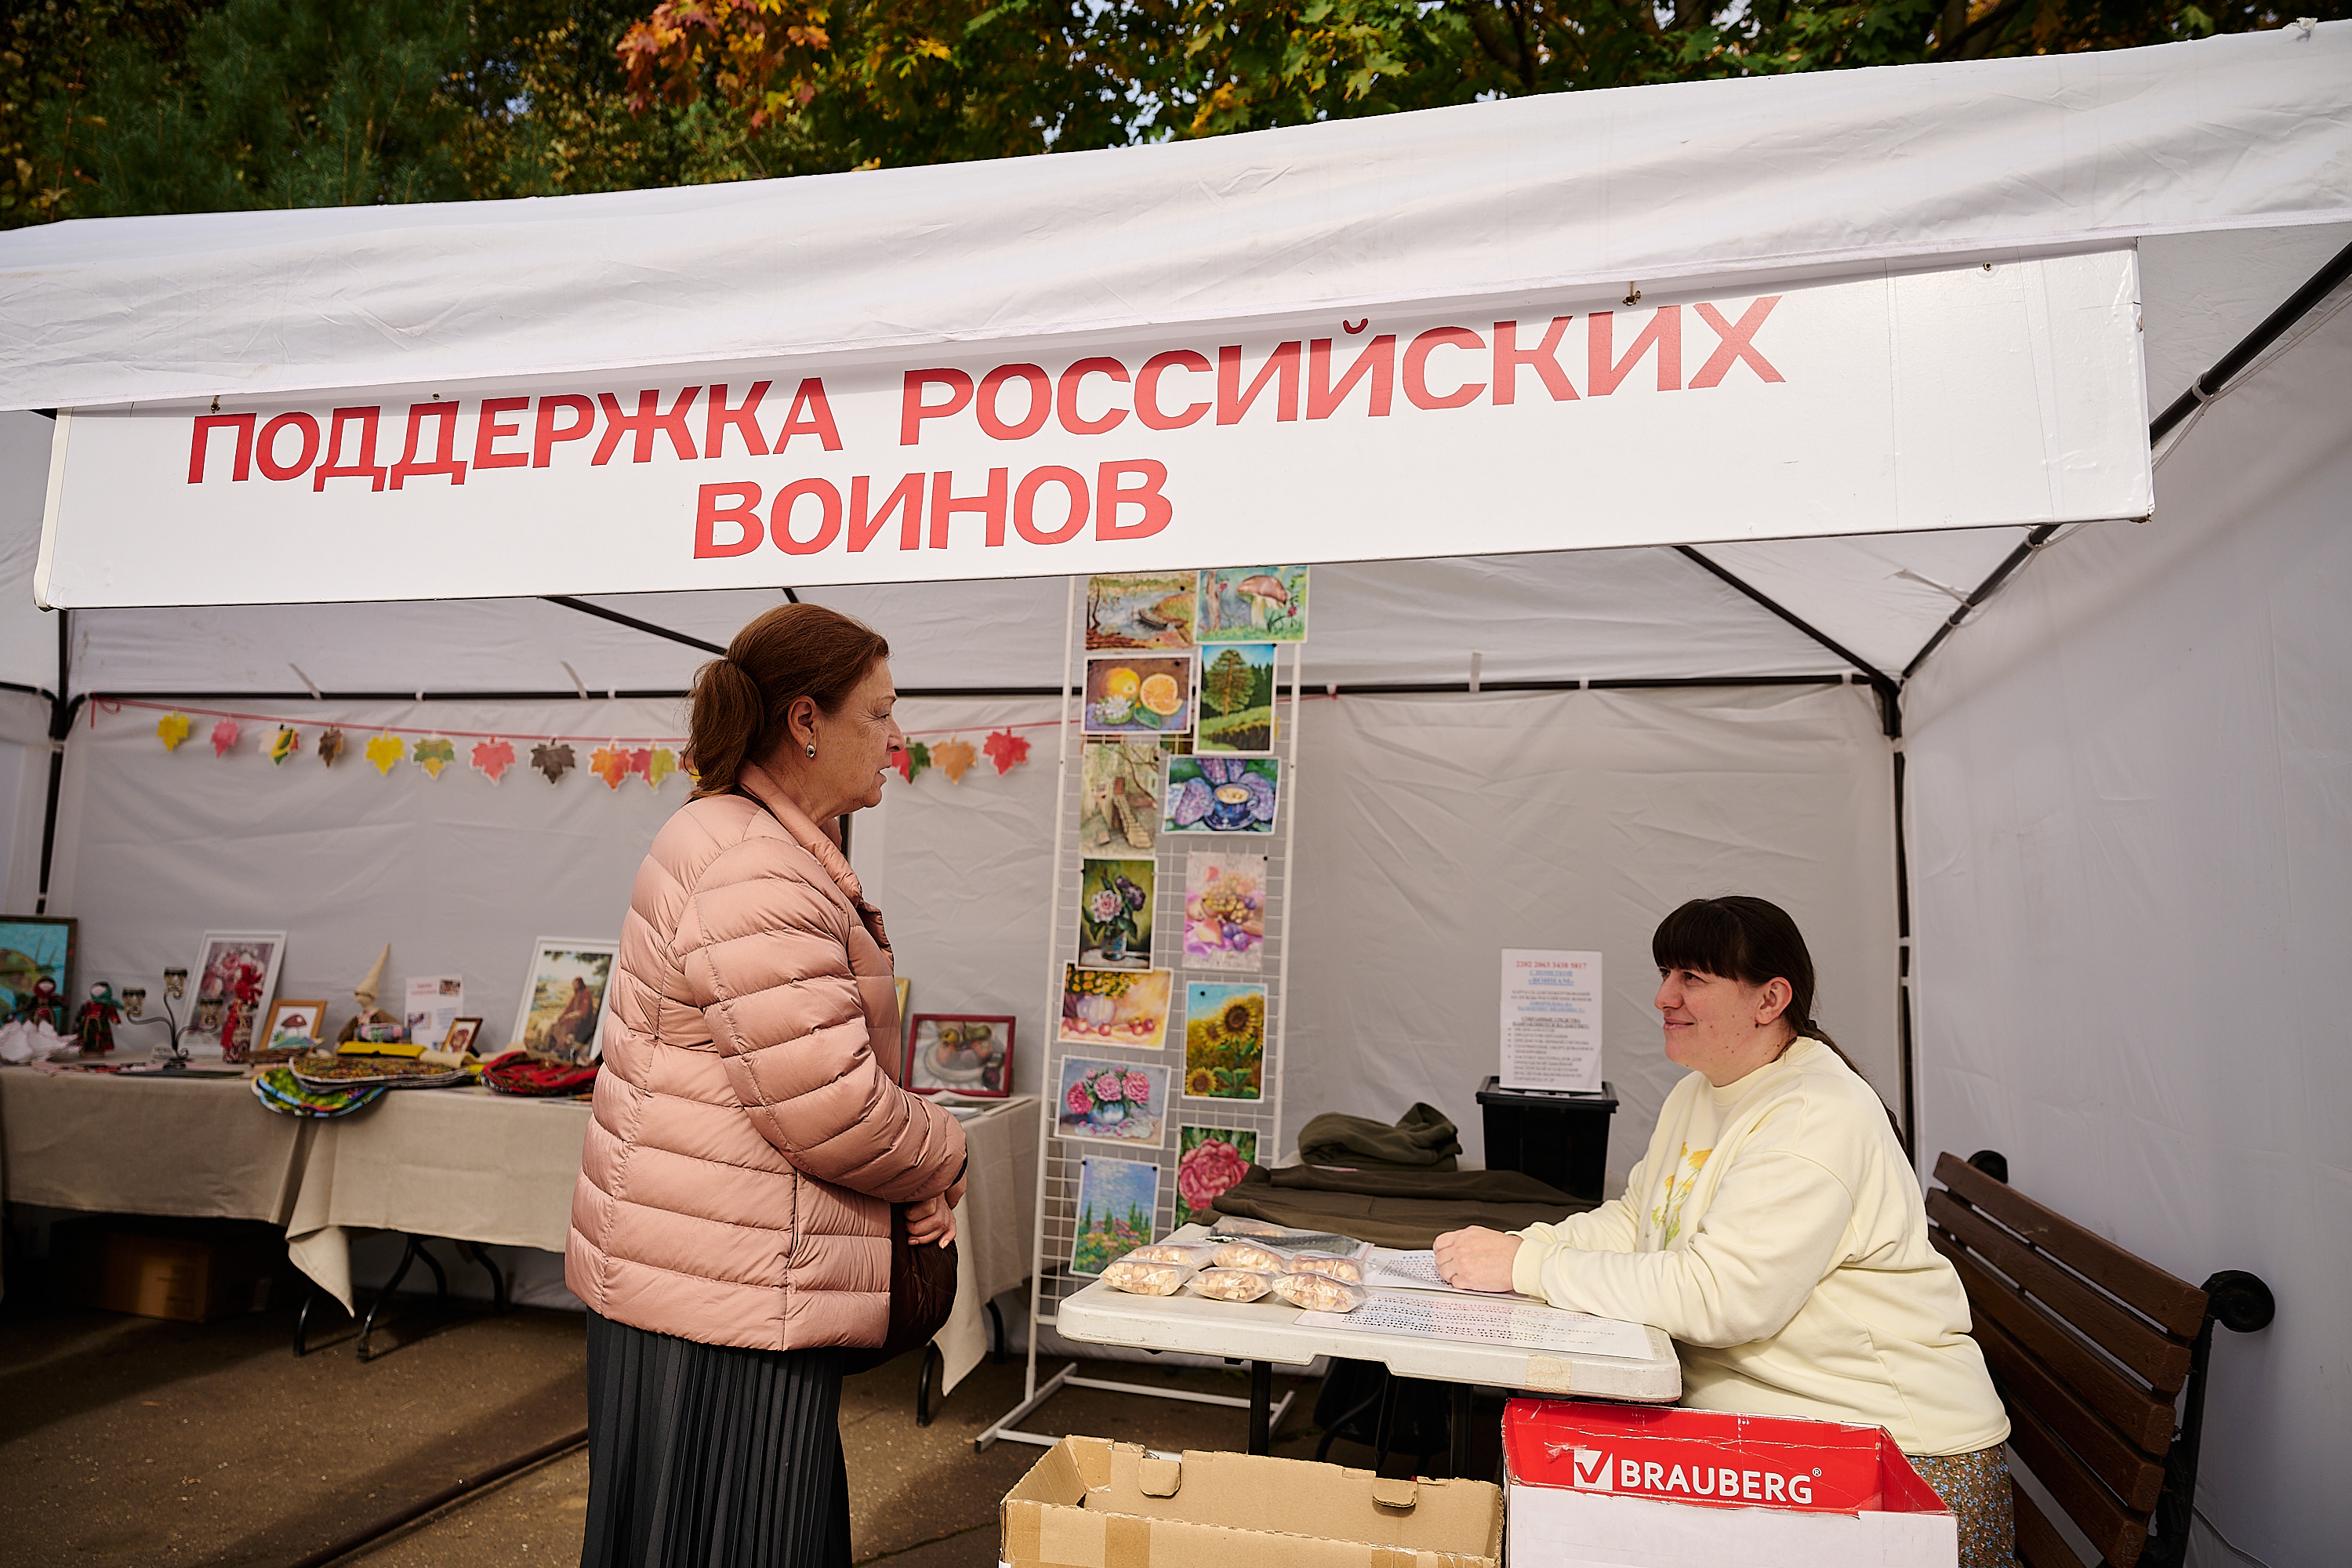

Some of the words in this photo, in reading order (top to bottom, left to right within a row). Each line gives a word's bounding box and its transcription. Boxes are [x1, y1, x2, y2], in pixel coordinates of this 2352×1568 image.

[187, 377, 844, 492] ПОДДЕРЖКА
[899, 296, 1786, 446] РОССИЙСКИХ
[693, 458, 1173, 560] ВОИНОВ
